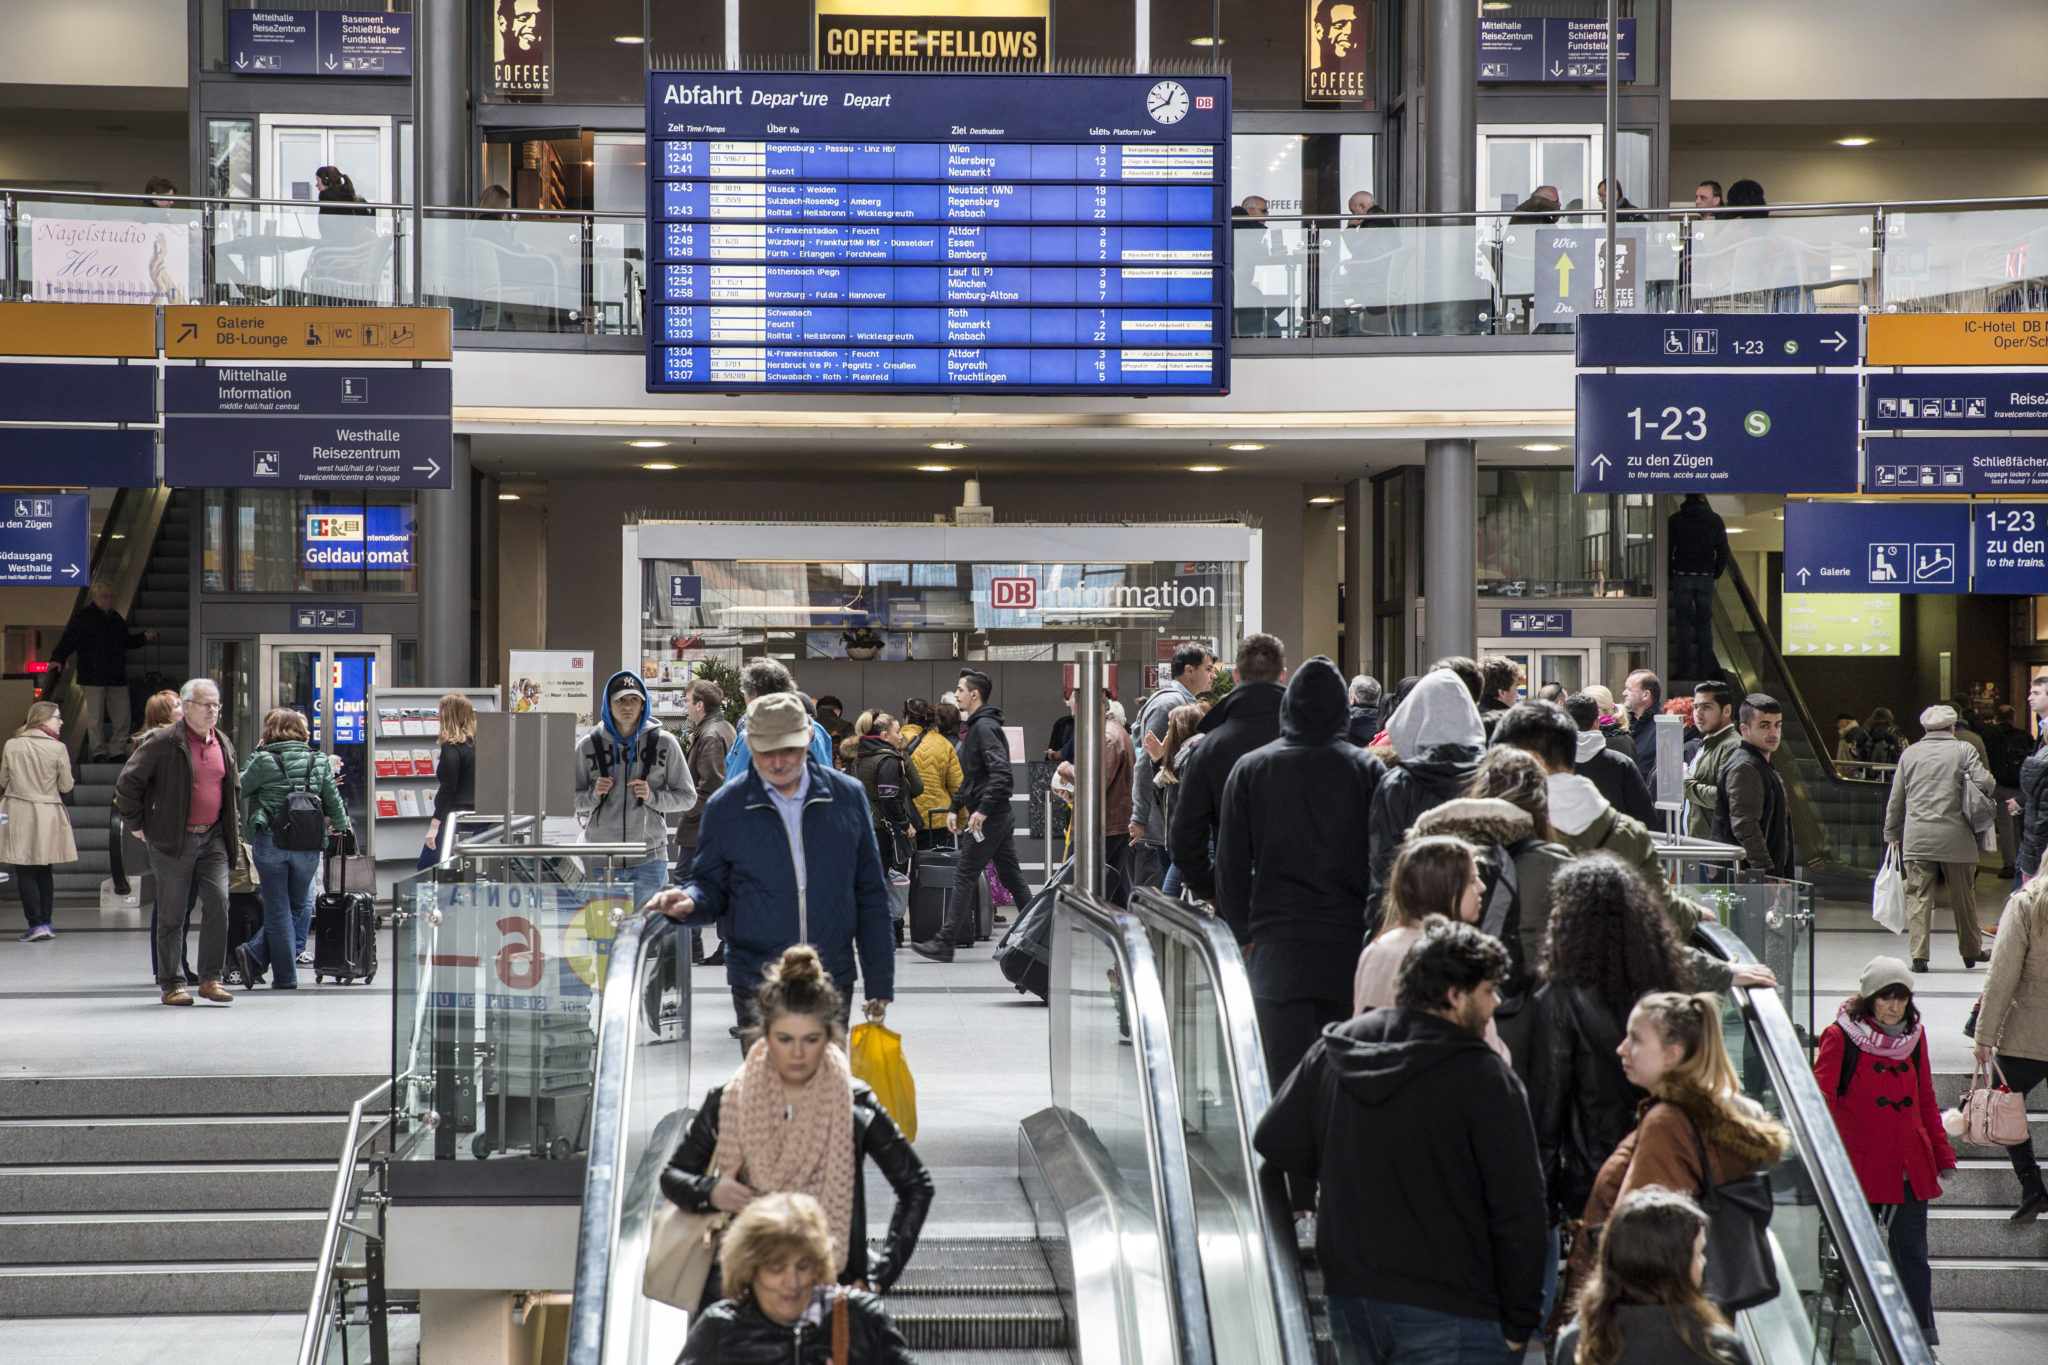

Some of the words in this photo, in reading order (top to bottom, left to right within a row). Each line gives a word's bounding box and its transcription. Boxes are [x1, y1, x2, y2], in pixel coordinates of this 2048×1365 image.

[253, 14, 293, 22] Mittelhalle
[342, 15, 383, 23] Basement
[253, 24, 305, 32] ReiseZentrum
[343, 25, 400, 34] Schließfächer
[343, 35, 386, 44] Fundstelle
[1482, 32, 1532, 40] ReiseZentrum
[1568, 32, 1625, 40] Schließfäer
[828, 29, 918, 56] COFFEE
[927, 30, 1037, 58] FELLOWS
[495, 64, 549, 82] COFFEE
[1311, 72, 1364, 89] COFFEE
[664, 85, 742, 104] Abfahrt
[843, 93, 891, 109] Depart
[1197, 98, 1212, 108] DB
[668, 124, 684, 132] Zeit
[767, 123, 787, 133] Über
[951, 126, 966, 135] Ziel
[668, 142, 691, 150] 12:31
[949, 144, 970, 153] Wien
[668, 153, 692, 162] 12:40
[949, 156, 995, 167] Allersberg
[668, 165, 691, 173] 12:41
[949, 167, 990, 176] Neumarkt
[668, 183, 692, 191] 12:43
[949, 186, 988, 194] Neustadt
[949, 197, 999, 208] Regensburg
[668, 206, 692, 215] 12:43
[949, 208, 985, 217] Ansbach
[669, 224, 692, 233] 12:44
[949, 227, 980, 235] Altdorf
[38, 223, 146, 246] Nagelstudio
[669, 236, 693, 244] 12:49
[949, 238, 974, 247] Essen
[669, 247, 693, 256] 12:49
[948, 250, 987, 260] Bamberg
[57, 249, 119, 278] Hoa
[669, 265, 693, 274] 12:53
[949, 268, 967, 276] Lauf
[669, 277, 692, 285] 12:54
[948, 279, 986, 288] München
[67, 286, 90, 295] finden
[107, 288, 116, 296] im
[117, 289, 169, 298] Obergeschoss
[669, 289, 693, 297] 12:58
[948, 291, 1018, 301] Hamburg-Altona
[669, 306, 692, 315] 13:01
[948, 309, 968, 317] Roth
[1100, 309, 1104, 318] 1
[217, 316, 264, 329] Galerie
[669, 318, 692, 326] 13:01
[948, 320, 990, 328] Neumarkt
[1100, 321, 1105, 329] 2
[1965, 321, 2015, 333] IC-Hotel
[2023, 321, 2041, 332] DB
[335, 328, 353, 339] WC
[669, 330, 693, 338] 13:03
[948, 332, 985, 340] Ansbach
[1094, 332, 1105, 340] 22
[216, 333, 288, 348] DB-Lounge
[1733, 341, 1763, 354] 1-23
[1785, 341, 1796, 353] S
[669, 348, 692, 356] 13:04
[948, 349, 979, 358] Altdorf
[1100, 350, 1105, 358] 3
[669, 359, 693, 367] 13:05
[948, 361, 987, 371] Bayreuth
[1095, 361, 1105, 370] 16
[219, 369, 287, 381] Mittelhalle
[669, 370, 693, 379] 13:07
[948, 372, 1006, 382] Treuchtlingen
[1099, 373, 1105, 381] 5
[219, 387, 291, 399] Information
[1627, 406, 1707, 441] 1-23
[1748, 414, 1766, 435] S
[337, 430, 400, 441] Westhalle
[313, 447, 400, 459] Reisezentrum
[1628, 457, 1641, 465] zu
[1646, 454, 1669, 465] den
[1673, 454, 1713, 468] Zügen
[7, 520, 23, 528] den
[25, 520, 52, 530] Zügen
[1987, 511, 2035, 532] 1-23
[1987, 540, 2007, 553] zu
[2013, 537, 2045, 553] den
[1987, 558, 1996, 567] to
[1999, 557, 2014, 567] the
[8, 564, 52, 572] Westhalle
[997, 583, 1031, 603] DB
